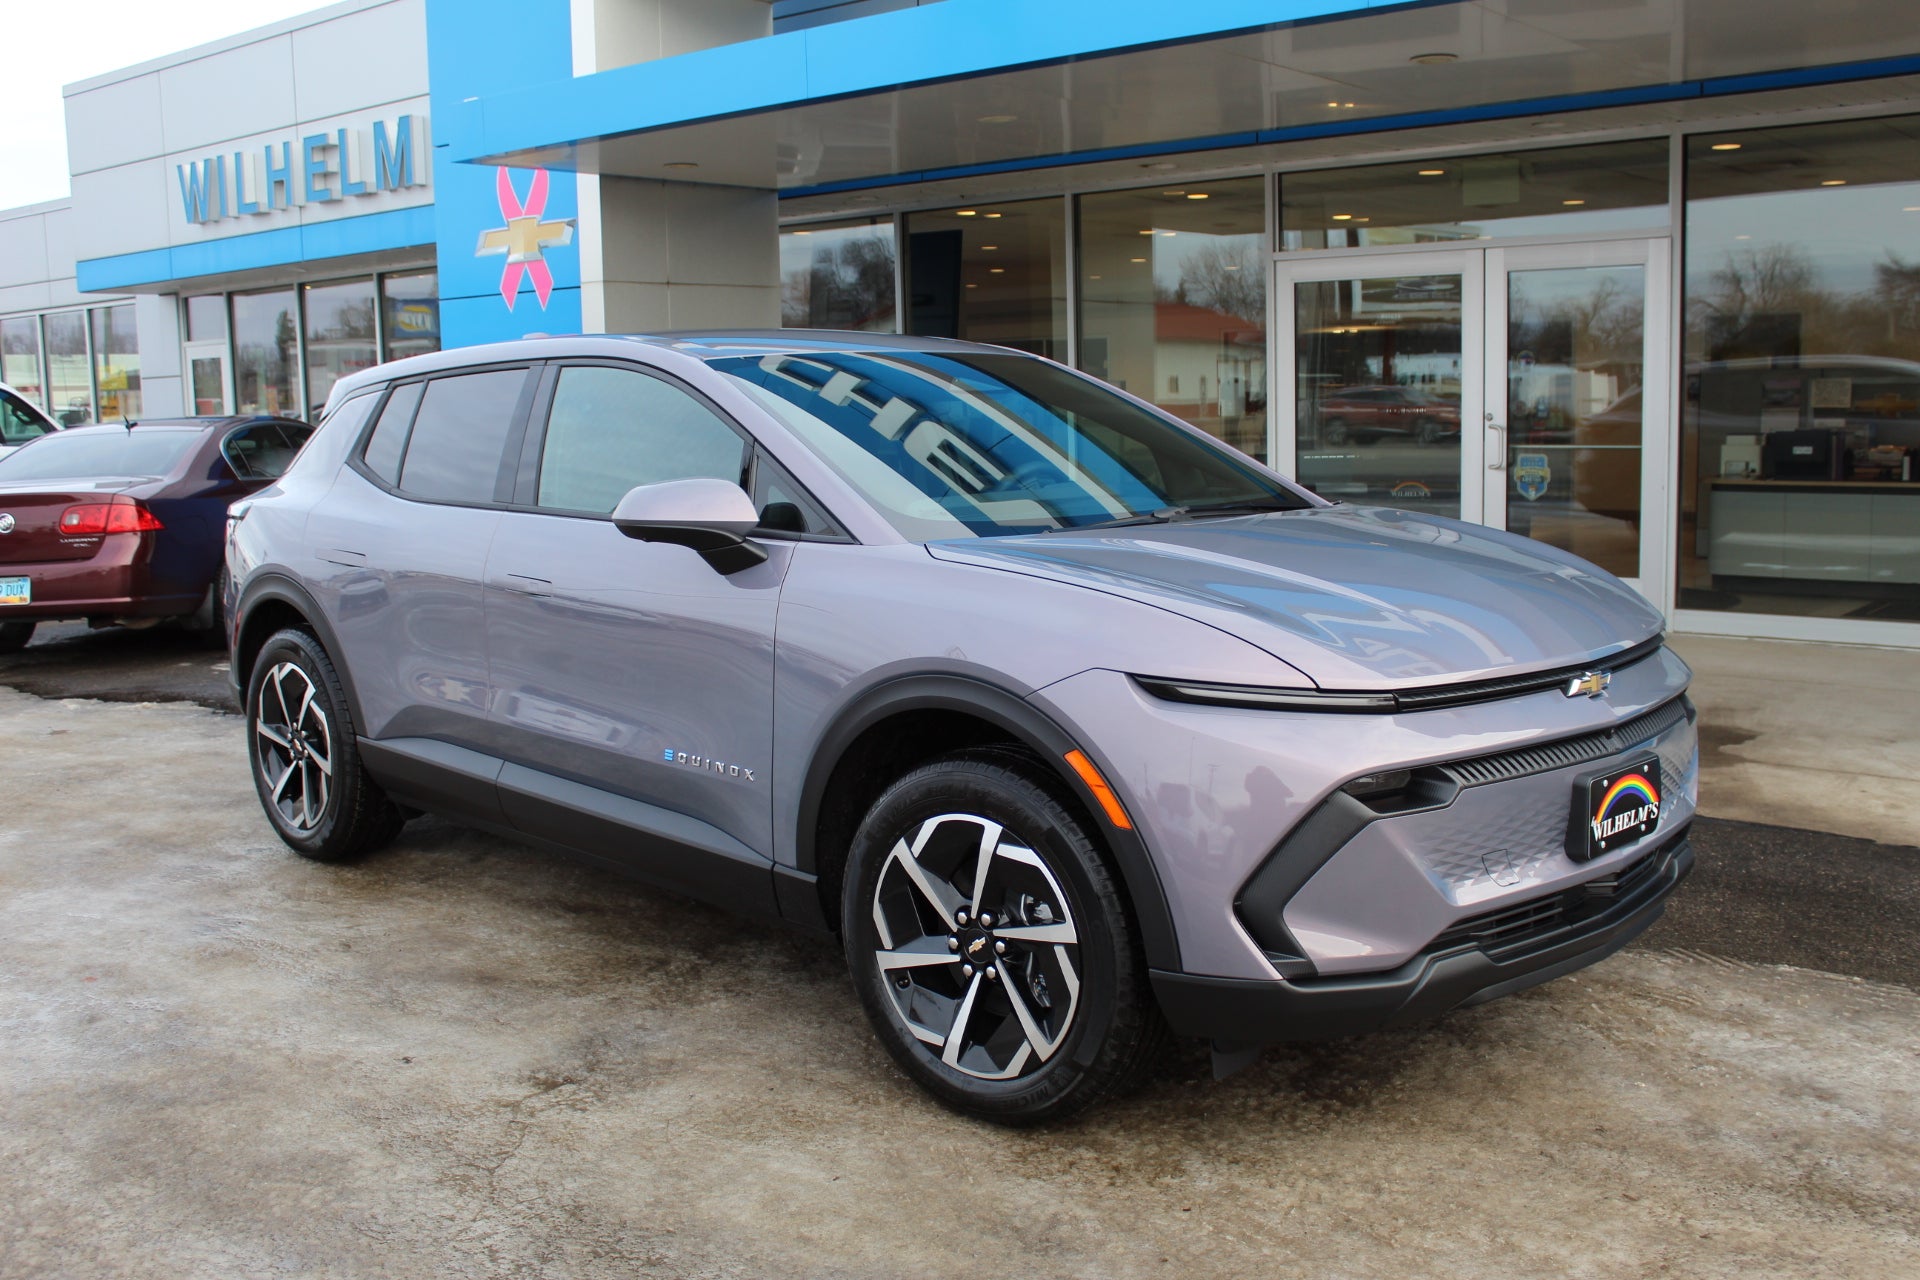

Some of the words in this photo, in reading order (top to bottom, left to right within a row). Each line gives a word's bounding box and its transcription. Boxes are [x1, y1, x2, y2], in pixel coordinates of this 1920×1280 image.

[176, 114, 424, 224] WILHELM
[6, 584, 25, 596] DUX
[664, 748, 754, 781] EQUINOX
[1590, 801, 1659, 842] WILHELM'S
